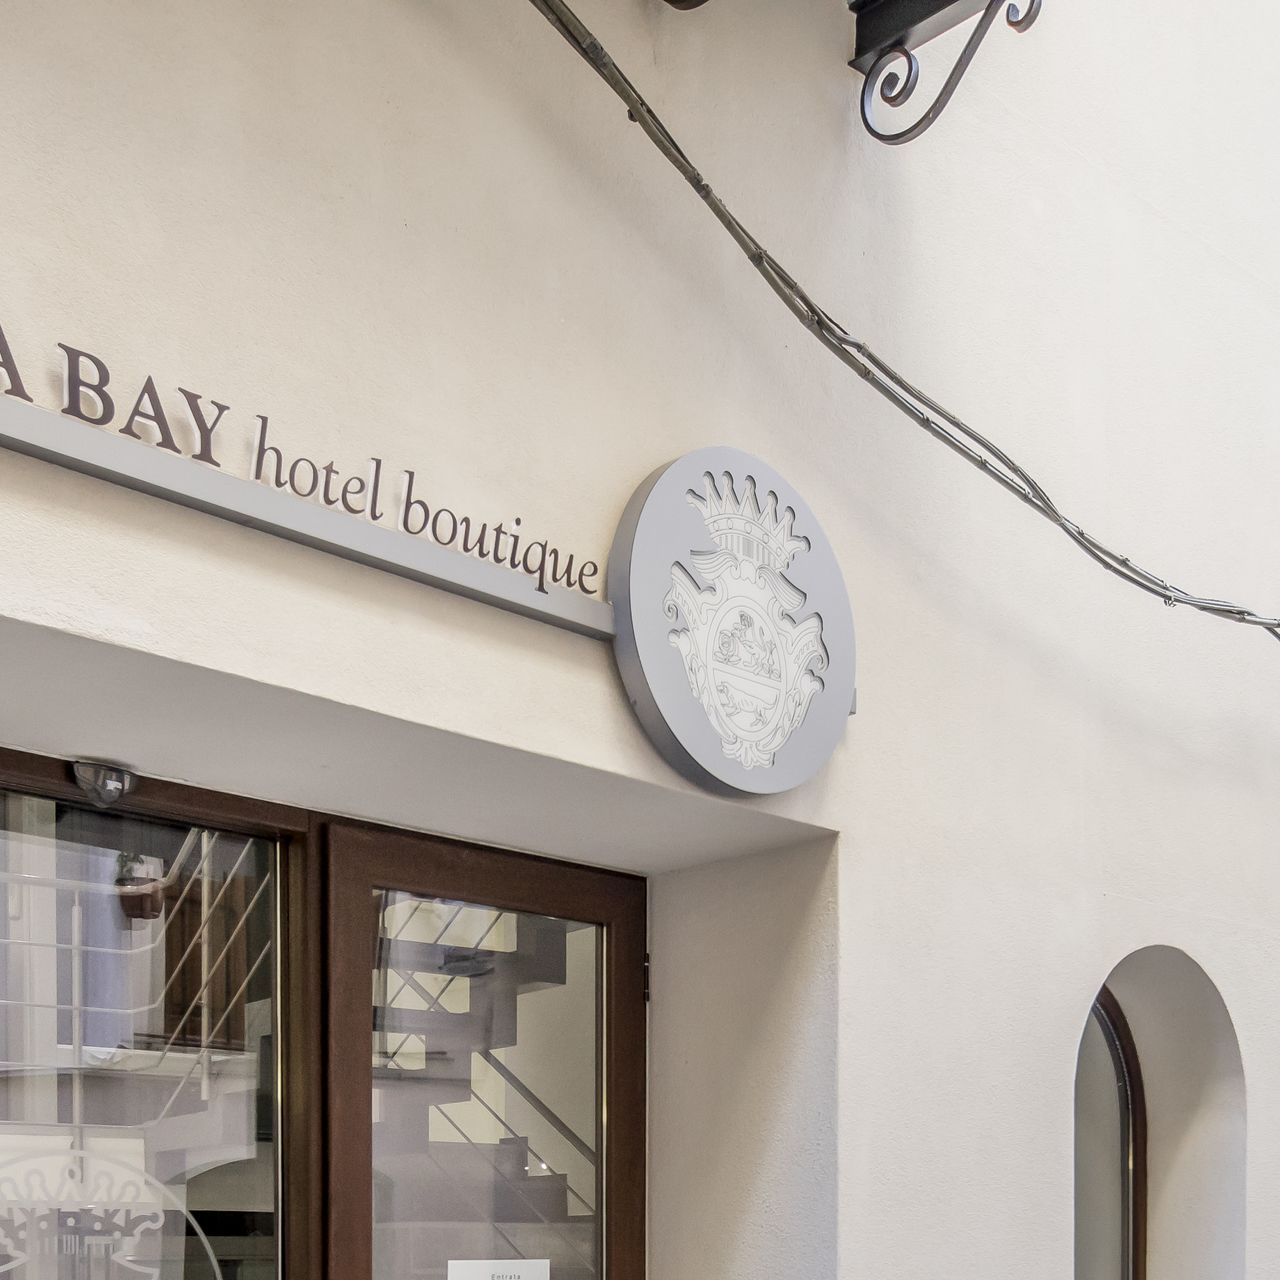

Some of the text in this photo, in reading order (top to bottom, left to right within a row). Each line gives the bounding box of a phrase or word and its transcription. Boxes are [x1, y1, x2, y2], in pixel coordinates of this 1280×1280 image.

[56, 342, 231, 469] BAY
[254, 414, 384, 521] hotel
[402, 470, 600, 595] boutique
